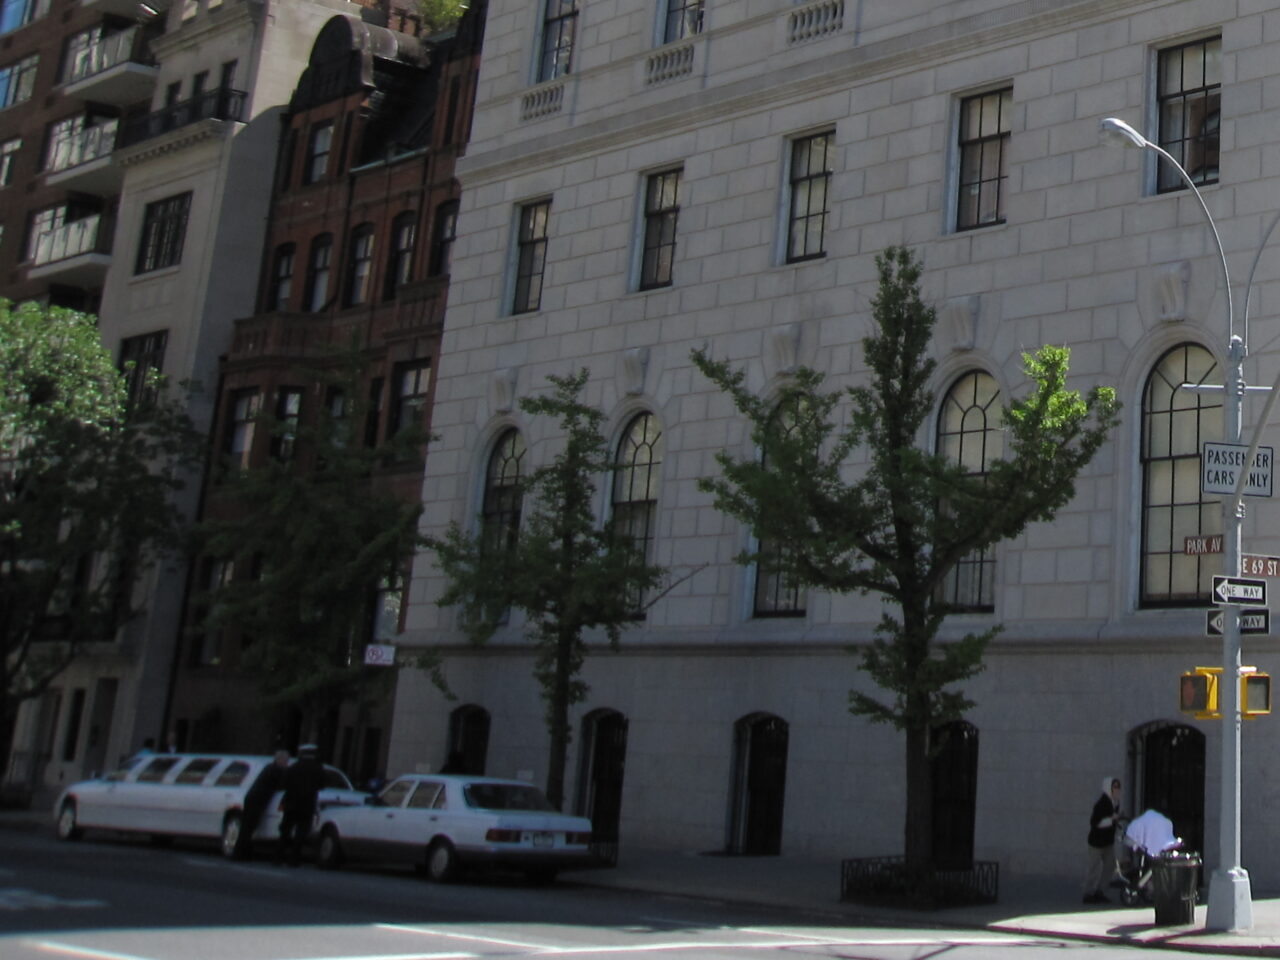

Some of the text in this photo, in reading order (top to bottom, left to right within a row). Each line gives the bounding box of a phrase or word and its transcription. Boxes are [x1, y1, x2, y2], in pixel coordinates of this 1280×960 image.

[1207, 449, 1269, 468] PASSENER
[1206, 469, 1268, 488] CARS NLY
[1187, 536, 1222, 554] PARK AV
[1242, 558, 1278, 577] E 69 ST
[1221, 584, 1260, 598] ONE WAY
[1242, 617, 1260, 628] WAY
